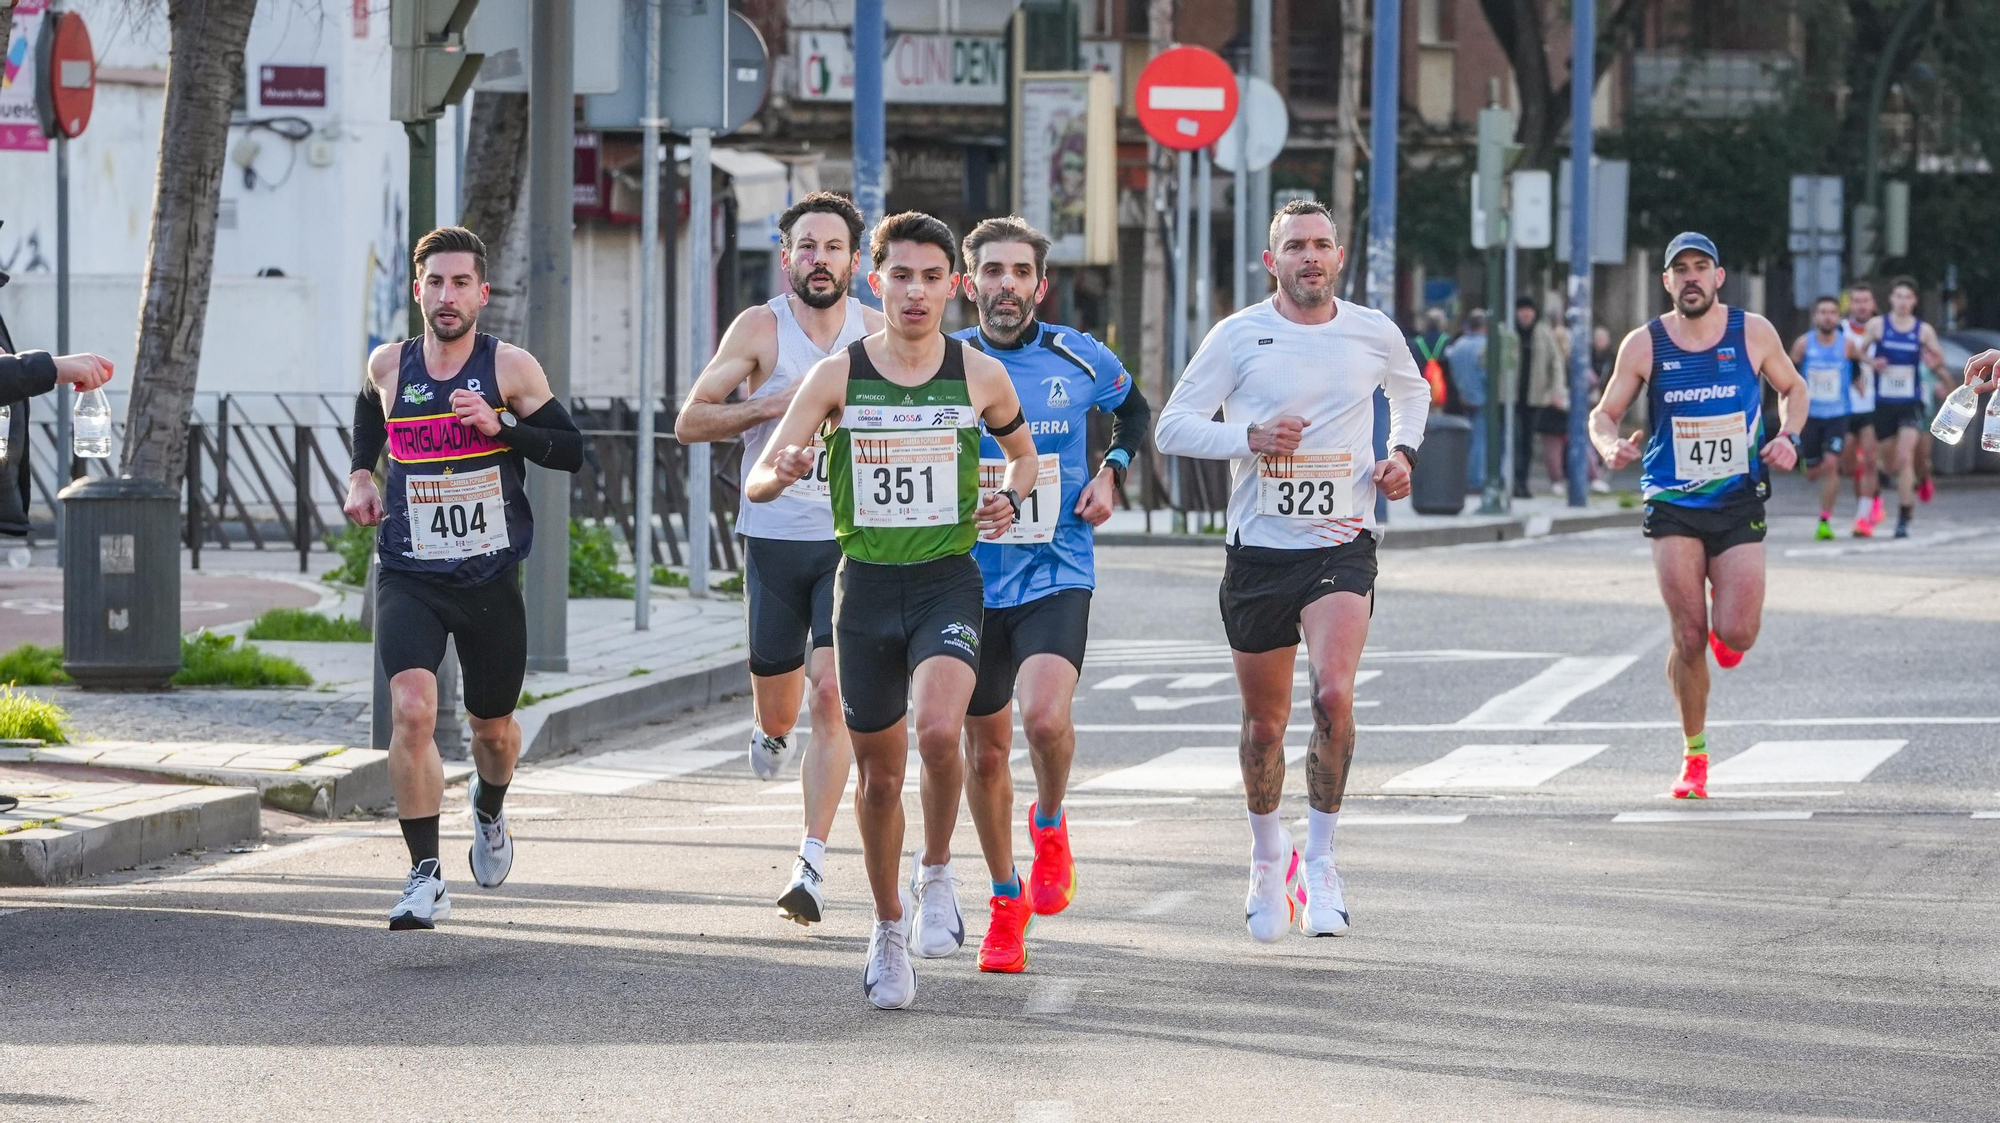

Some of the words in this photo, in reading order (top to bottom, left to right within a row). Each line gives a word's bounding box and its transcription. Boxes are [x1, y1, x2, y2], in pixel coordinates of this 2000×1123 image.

[1664, 384, 1736, 403] enerplus
[856, 438, 889, 464] XLII
[1690, 438, 1732, 465] 479
[1263, 456, 1294, 478] XLII
[411, 481, 443, 504] XLII
[873, 466, 934, 505] 351
[1277, 480, 1334, 515] 323
[431, 502, 487, 538] 404
